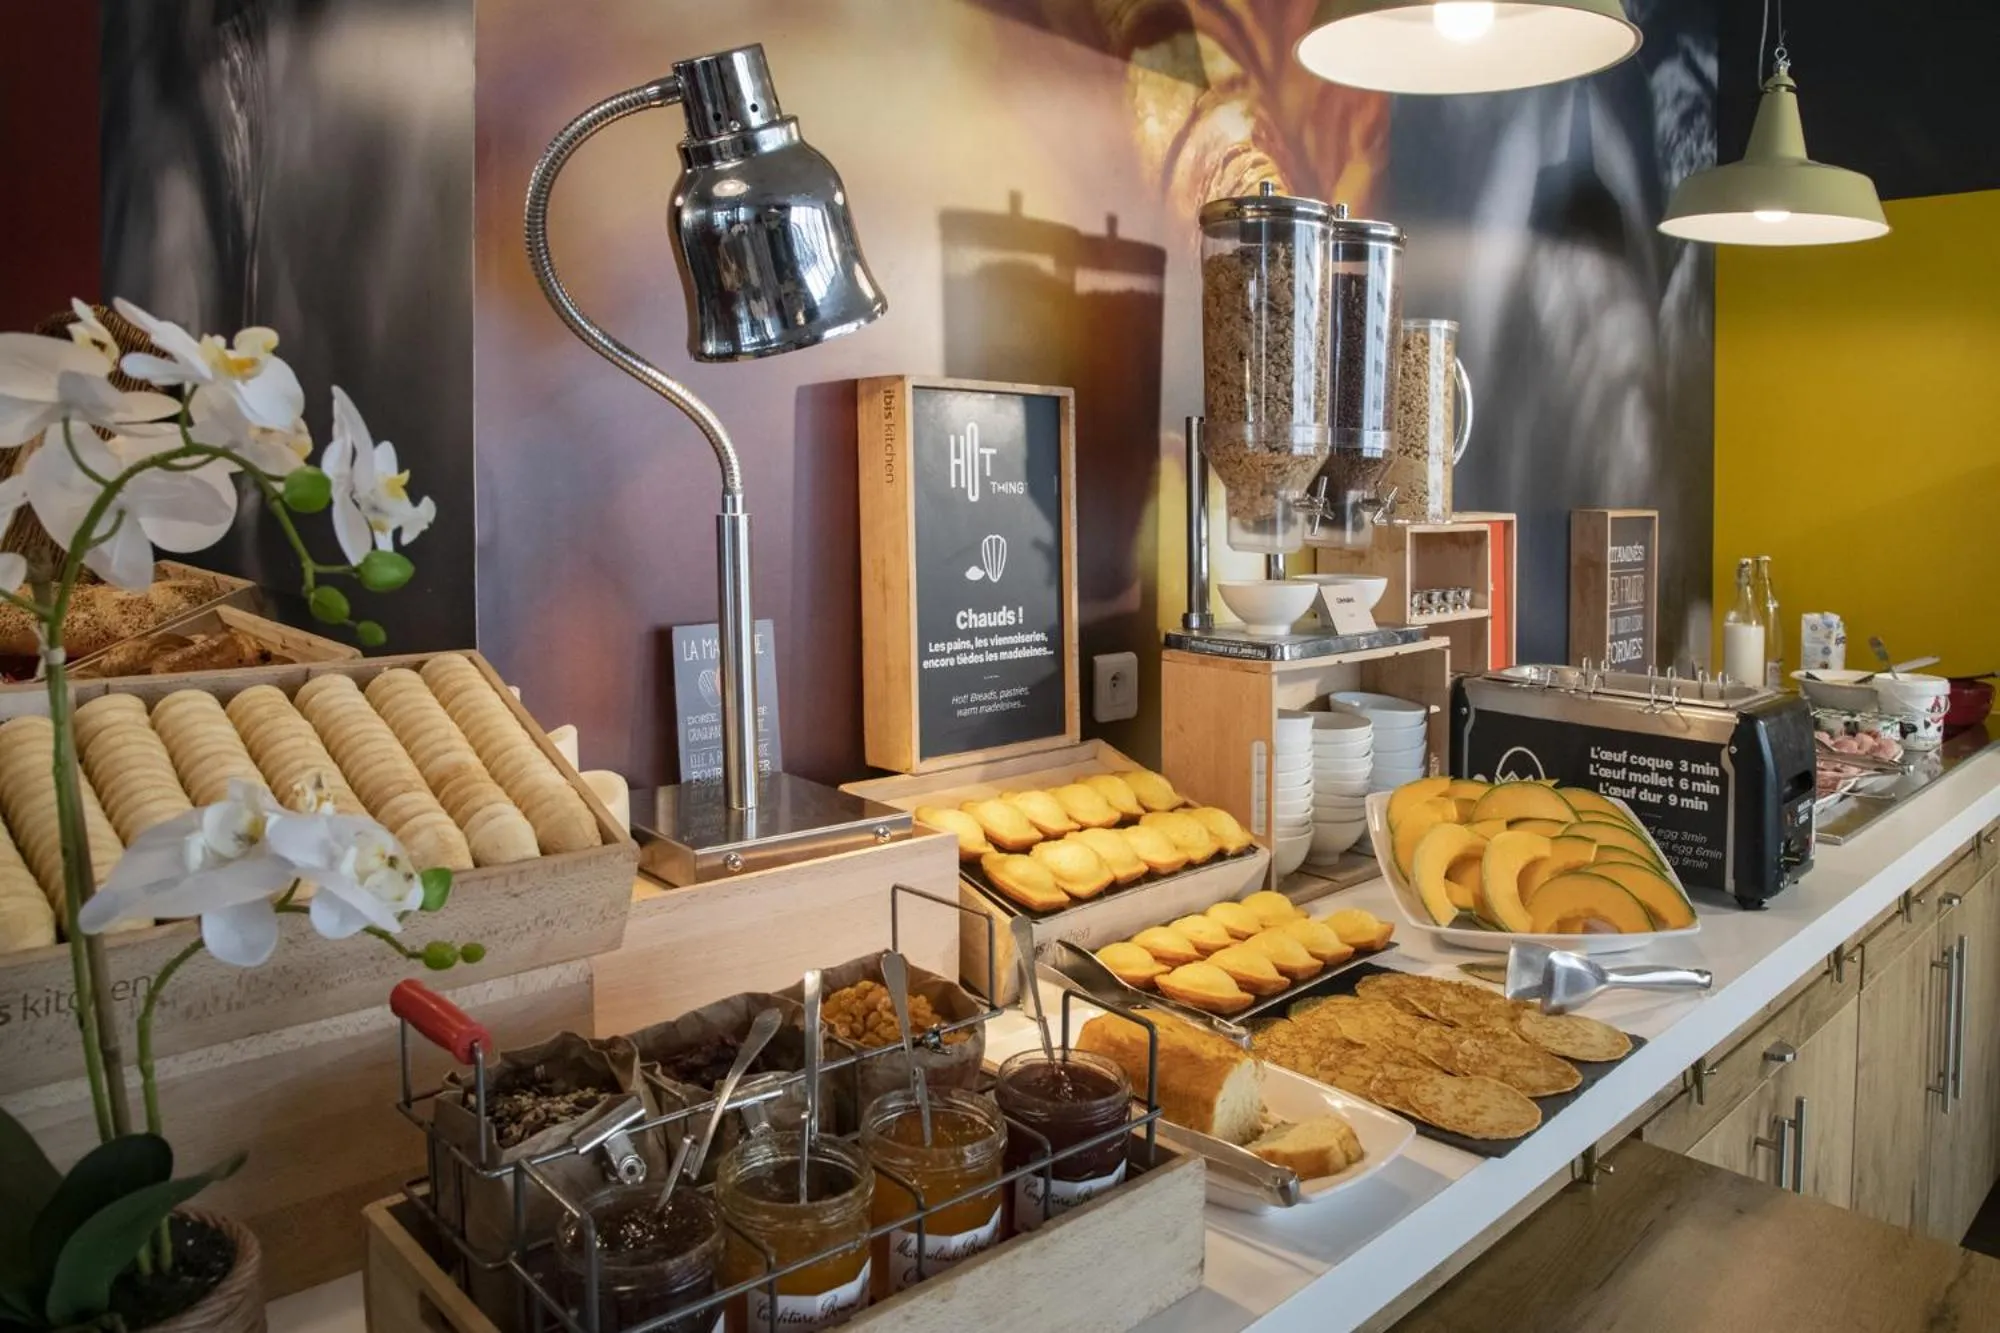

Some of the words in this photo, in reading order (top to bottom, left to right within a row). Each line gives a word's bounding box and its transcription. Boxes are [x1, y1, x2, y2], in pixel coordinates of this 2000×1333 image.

[883, 389, 896, 420] ibis
[884, 423, 897, 484] kitchen
[950, 421, 998, 502] HOT
[989, 481, 1025, 495] THING
[1610, 576, 1619, 606] ES
[956, 605, 1015, 630] Chauds
[1018, 606, 1024, 624] !
[683, 640, 700, 662] LA
[929, 642, 946, 653] Les
[947, 638, 974, 654] pains,
[974, 637, 989, 648] les
[990, 631, 1048, 647] viennoiseries,
[923, 656, 955, 669] encore
[956, 651, 984, 665] tièdes
[985, 650, 998, 662] les
[1630, 754, 1674, 771] coque
[1680, 760, 1689, 772] 3
[1691, 762, 1720, 777] min
[1629, 770, 1674, 788] mollet
[1679, 778, 1689, 790] 6
[1691, 780, 1720, 796] min
[1638, 788, 1663, 804] dur
[1668, 794, 1678, 806] 9
[1680, 796, 1709, 811] min
[1656, 828, 1679, 841] egg
[1681, 832, 1708, 844] 3min
[1671, 844, 1693, 857] egg
[22, 974, 151, 1021] kitcen
